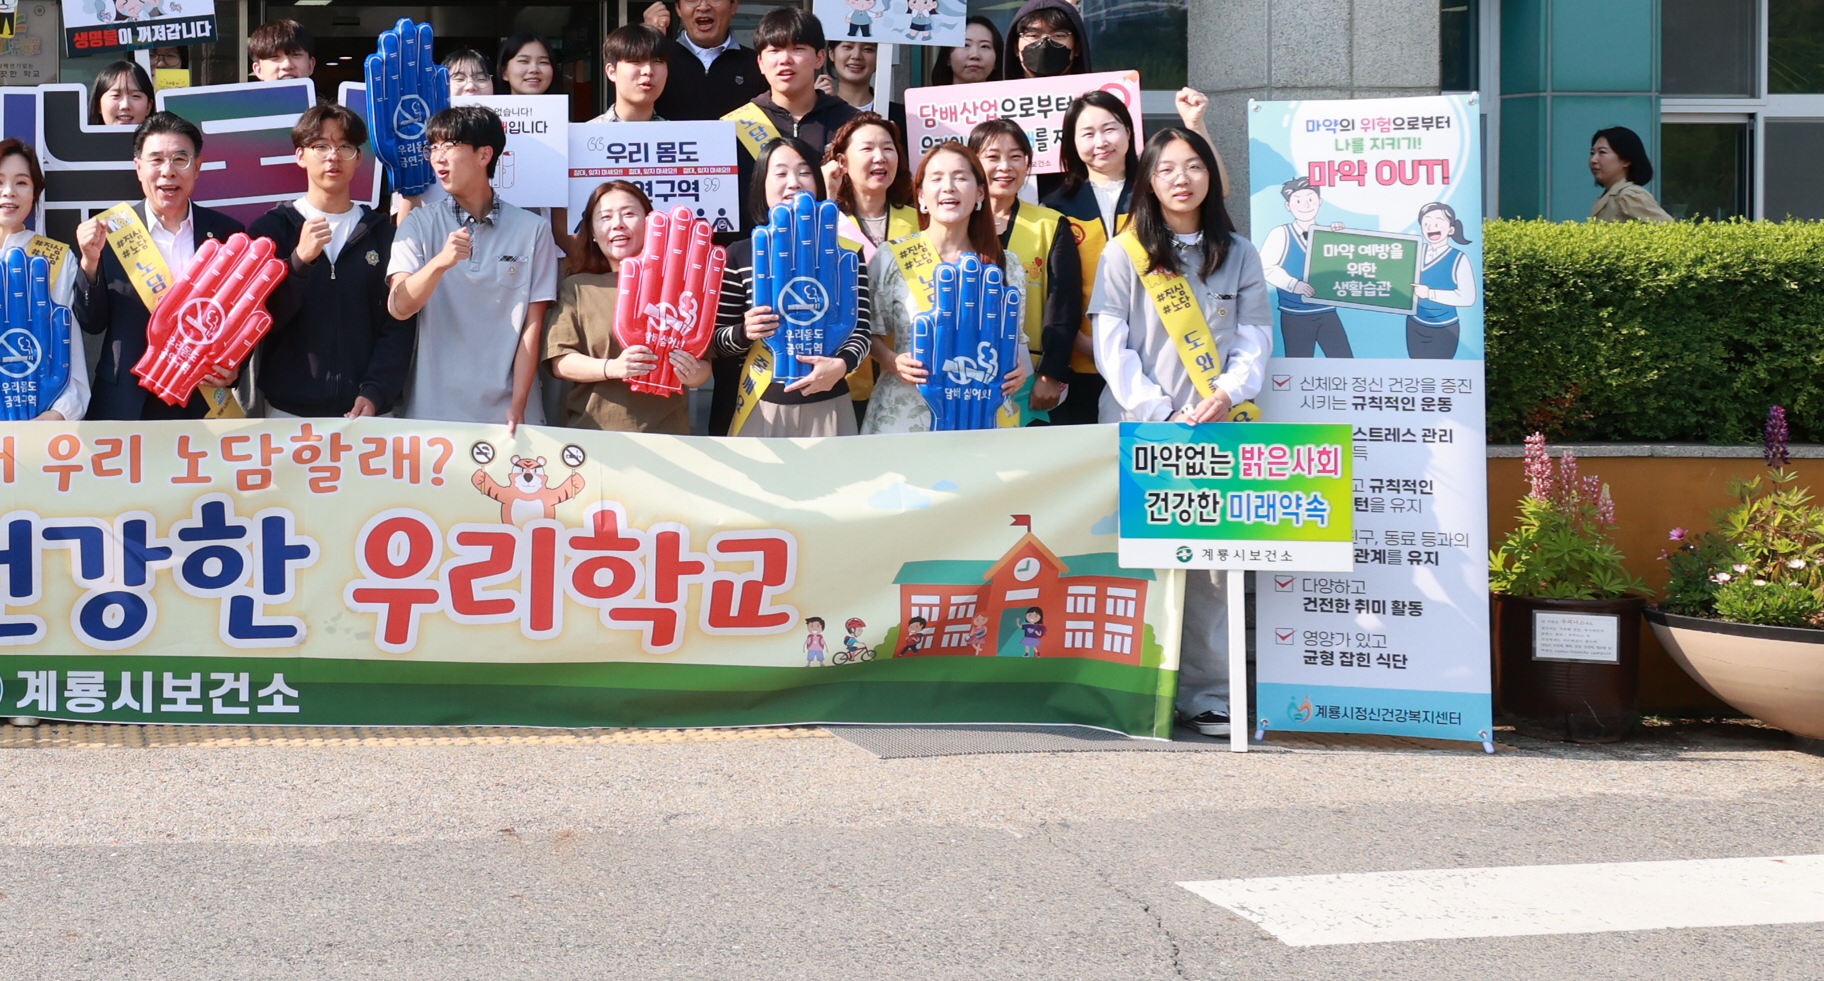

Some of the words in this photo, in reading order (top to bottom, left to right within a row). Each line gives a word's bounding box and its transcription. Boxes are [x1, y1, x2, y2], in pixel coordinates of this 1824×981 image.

[73, 28, 133, 49] 생명불이
[137, 20, 212, 43] 꺼져갑니다
[1306, 119, 1355, 132] 마약의
[1361, 117, 1451, 132] 위험으로부터
[606, 142, 649, 163] 우리
[656, 142, 699, 163] 몸도
[1335, 139, 1365, 153] 나를
[1370, 137, 1422, 151] 지키기!
[1308, 161, 1367, 187] 마약
[1376, 159, 1450, 186] OUT!
[632, 180, 699, 202] 연구역
[1323, 244, 1355, 258] 마약
[1358, 243, 1403, 259] 예방을
[1346, 263, 1377, 278] 위한
[1333, 282, 1392, 297] 생활습관
[1300, 378, 1347, 392] 신체와
[1352, 378, 1383, 392] 정신
[1388, 378, 1436, 392] 건강을
[1441, 379, 1472, 394] 증진
[1300, 396, 1347, 410] 시키는
[1351, 396, 1416, 412] 규칙적인
[1421, 397, 1452, 412] 운동
[1352, 427, 1417, 443] 스트레스
[1422, 428, 1453, 443] 관리
[42, 434, 142, 492] 우리
[170, 423, 454, 495] 노담할래?
[1135, 445, 1231, 476] 마약없는
[1241, 446, 1339, 477] 밝은사회
[1369, 479, 1433, 495] 규칙적인
[1147, 491, 1220, 523] 건강한
[1229, 494, 1327, 525] 미래약속
[1390, 497, 1422, 513] 유지
[1384, 530, 1416, 546] 동료
[1421, 531, 1469, 548] 등과의
[1201, 548, 1293, 562] 계룡시보건소
[1354, 549, 1402, 565] 관계를
[1407, 551, 1438, 566] 유지
[352, 509, 791, 651] 우리학교
[1303, 579, 1366, 594] 다양하고
[1303, 597, 1350, 615] 건전한
[1355, 597, 1387, 615] 취미
[1391, 599, 1424, 617] 활동
[1303, 631, 1351, 648] 영양가
[1356, 633, 1388, 649] 있고
[1303, 650, 1335, 667] 균형
[1339, 651, 1372, 668] 잡힌
[1376, 653, 1408, 669] 식단
[16, 669, 301, 715] 계룡시보건소
[1315, 704, 1462, 726] 계룡시정신건강복지센터
